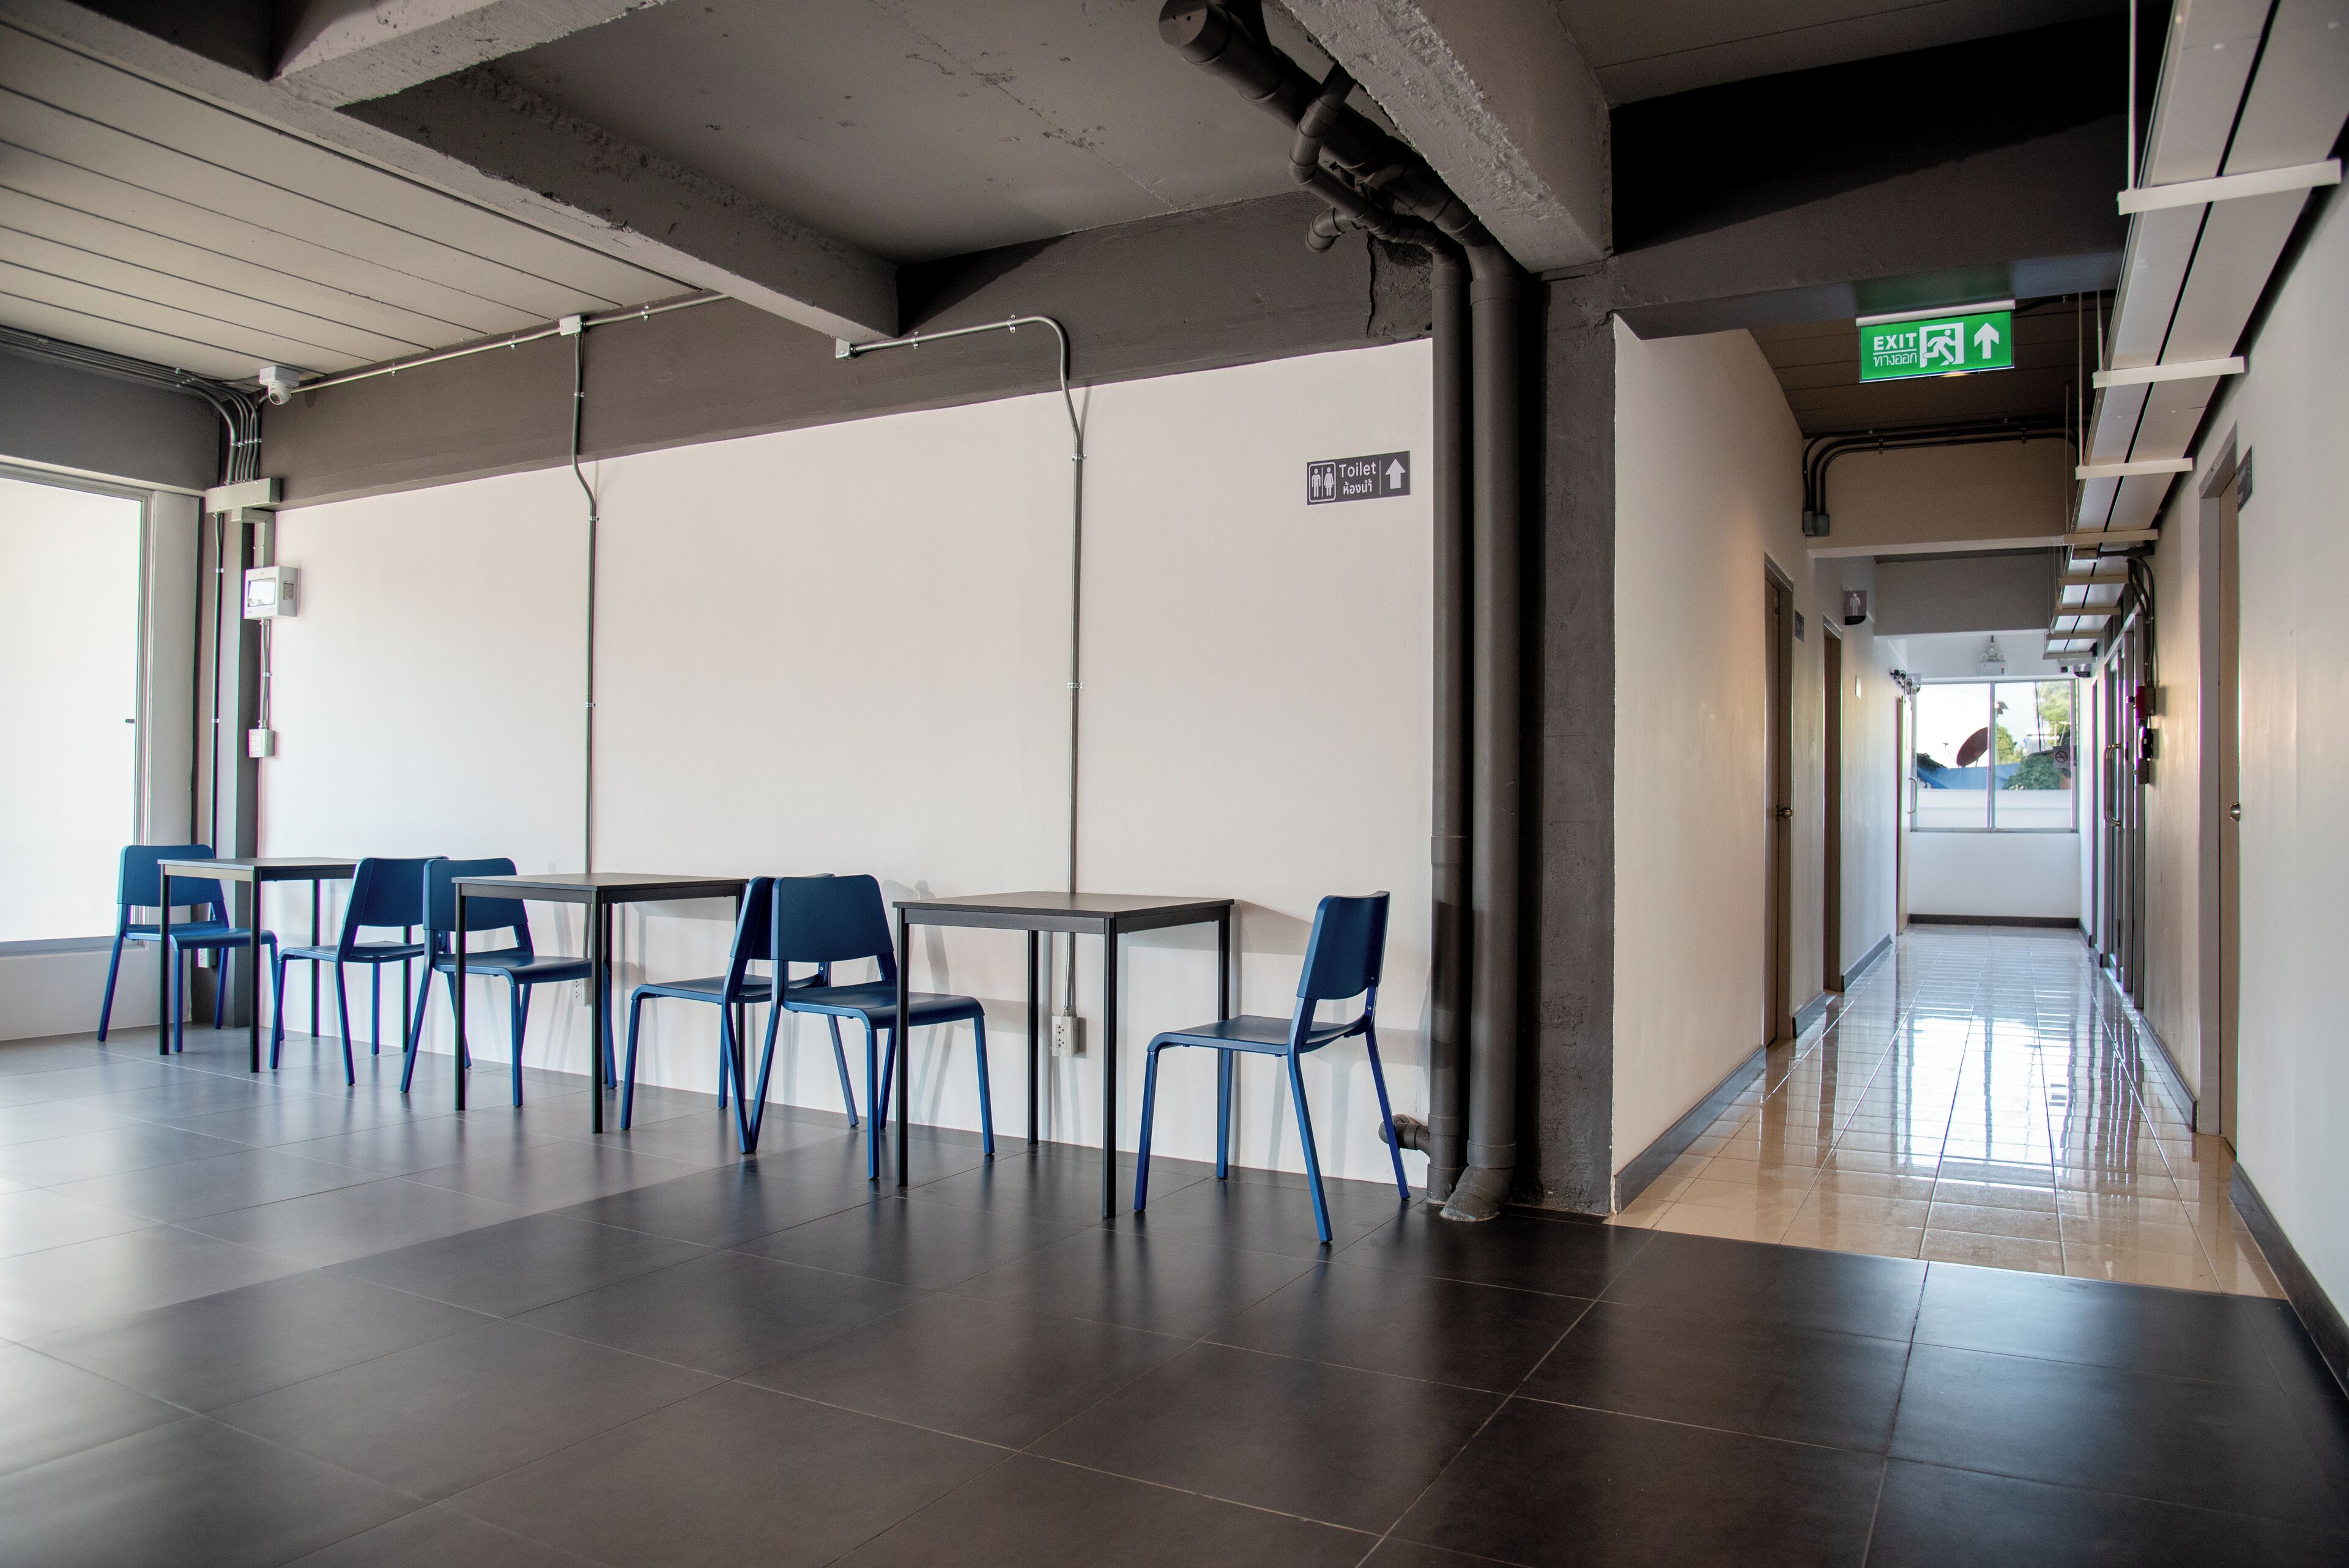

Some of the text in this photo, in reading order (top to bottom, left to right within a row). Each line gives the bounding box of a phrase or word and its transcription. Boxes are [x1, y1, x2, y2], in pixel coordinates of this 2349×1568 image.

[1874, 332, 1917, 351] EXIT
[1873, 353, 1918, 366] ทางออก
[1338, 461, 1376, 478] Toilet
